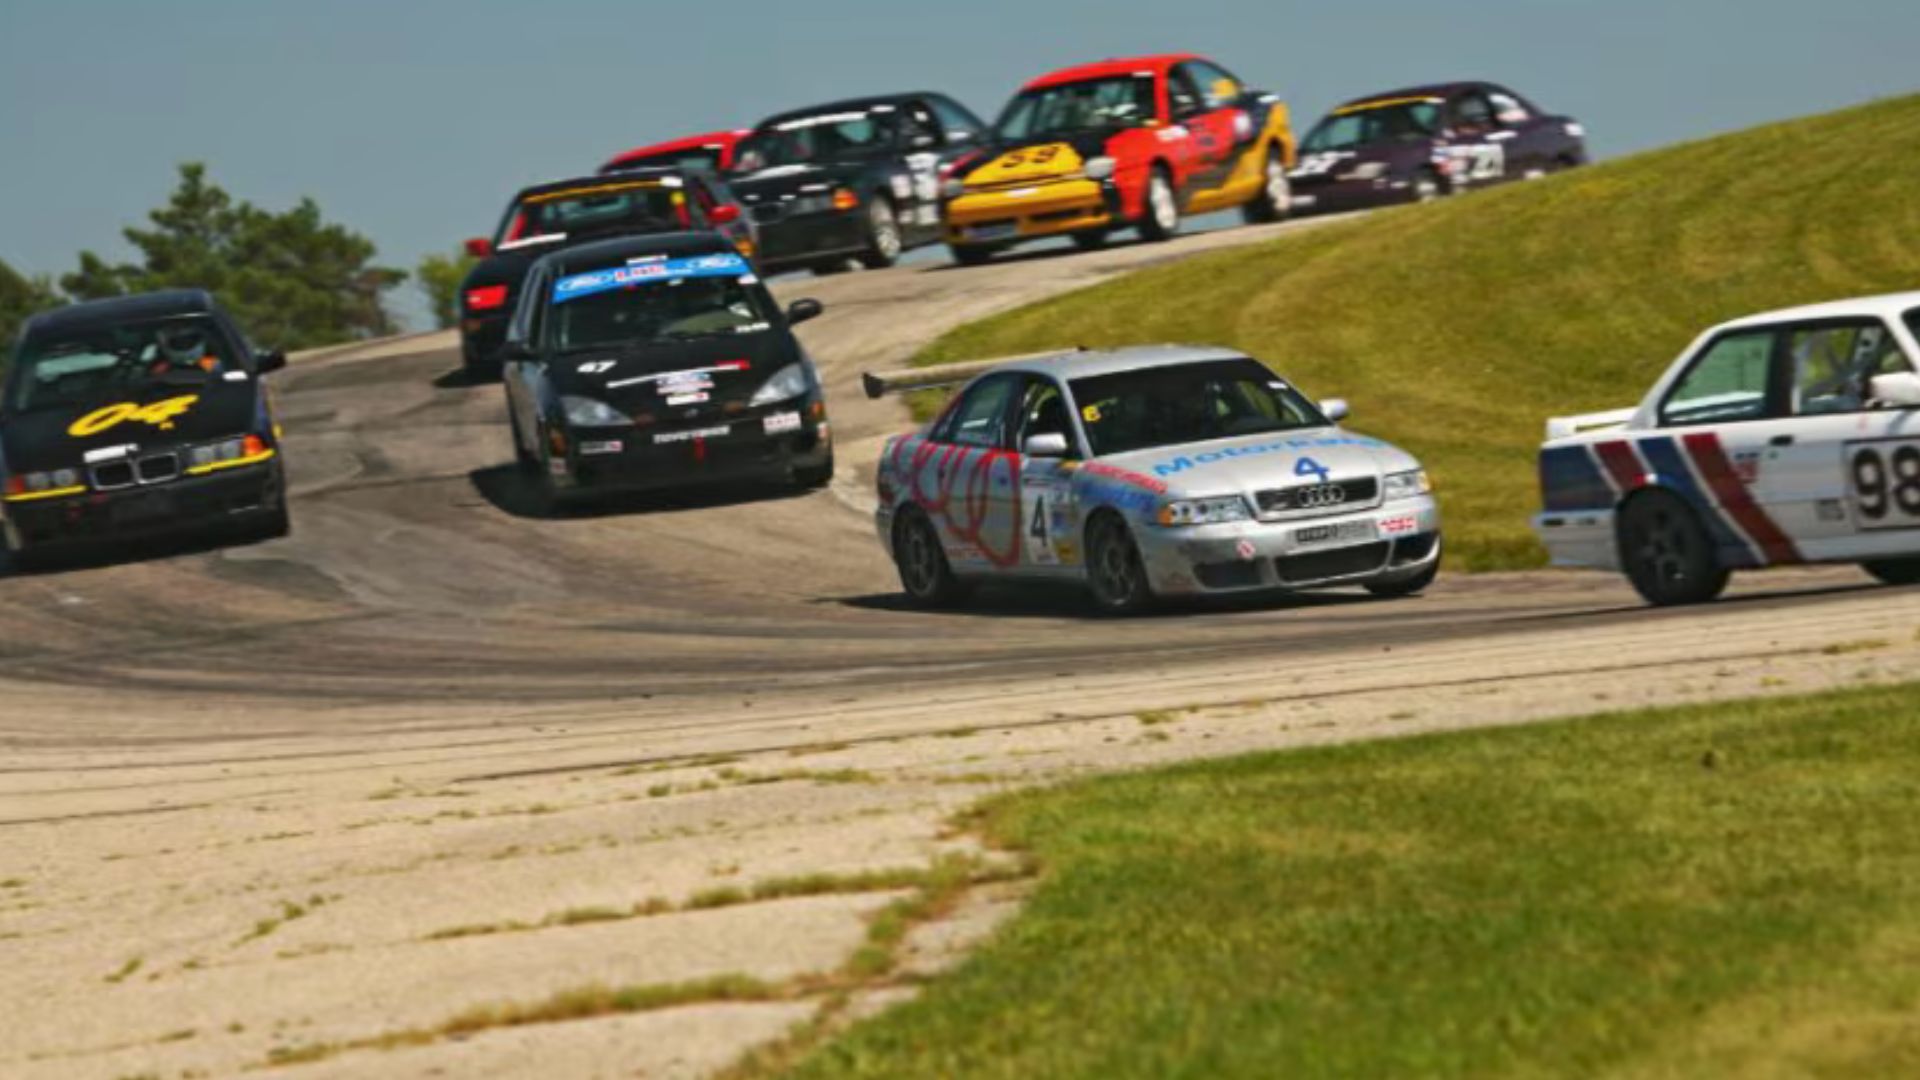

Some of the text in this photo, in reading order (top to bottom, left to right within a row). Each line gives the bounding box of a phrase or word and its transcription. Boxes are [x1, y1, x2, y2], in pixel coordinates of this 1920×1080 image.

[1294, 457, 1329, 481] 4
[1853, 444, 1920, 519] 98
[1030, 494, 1047, 548] 4
